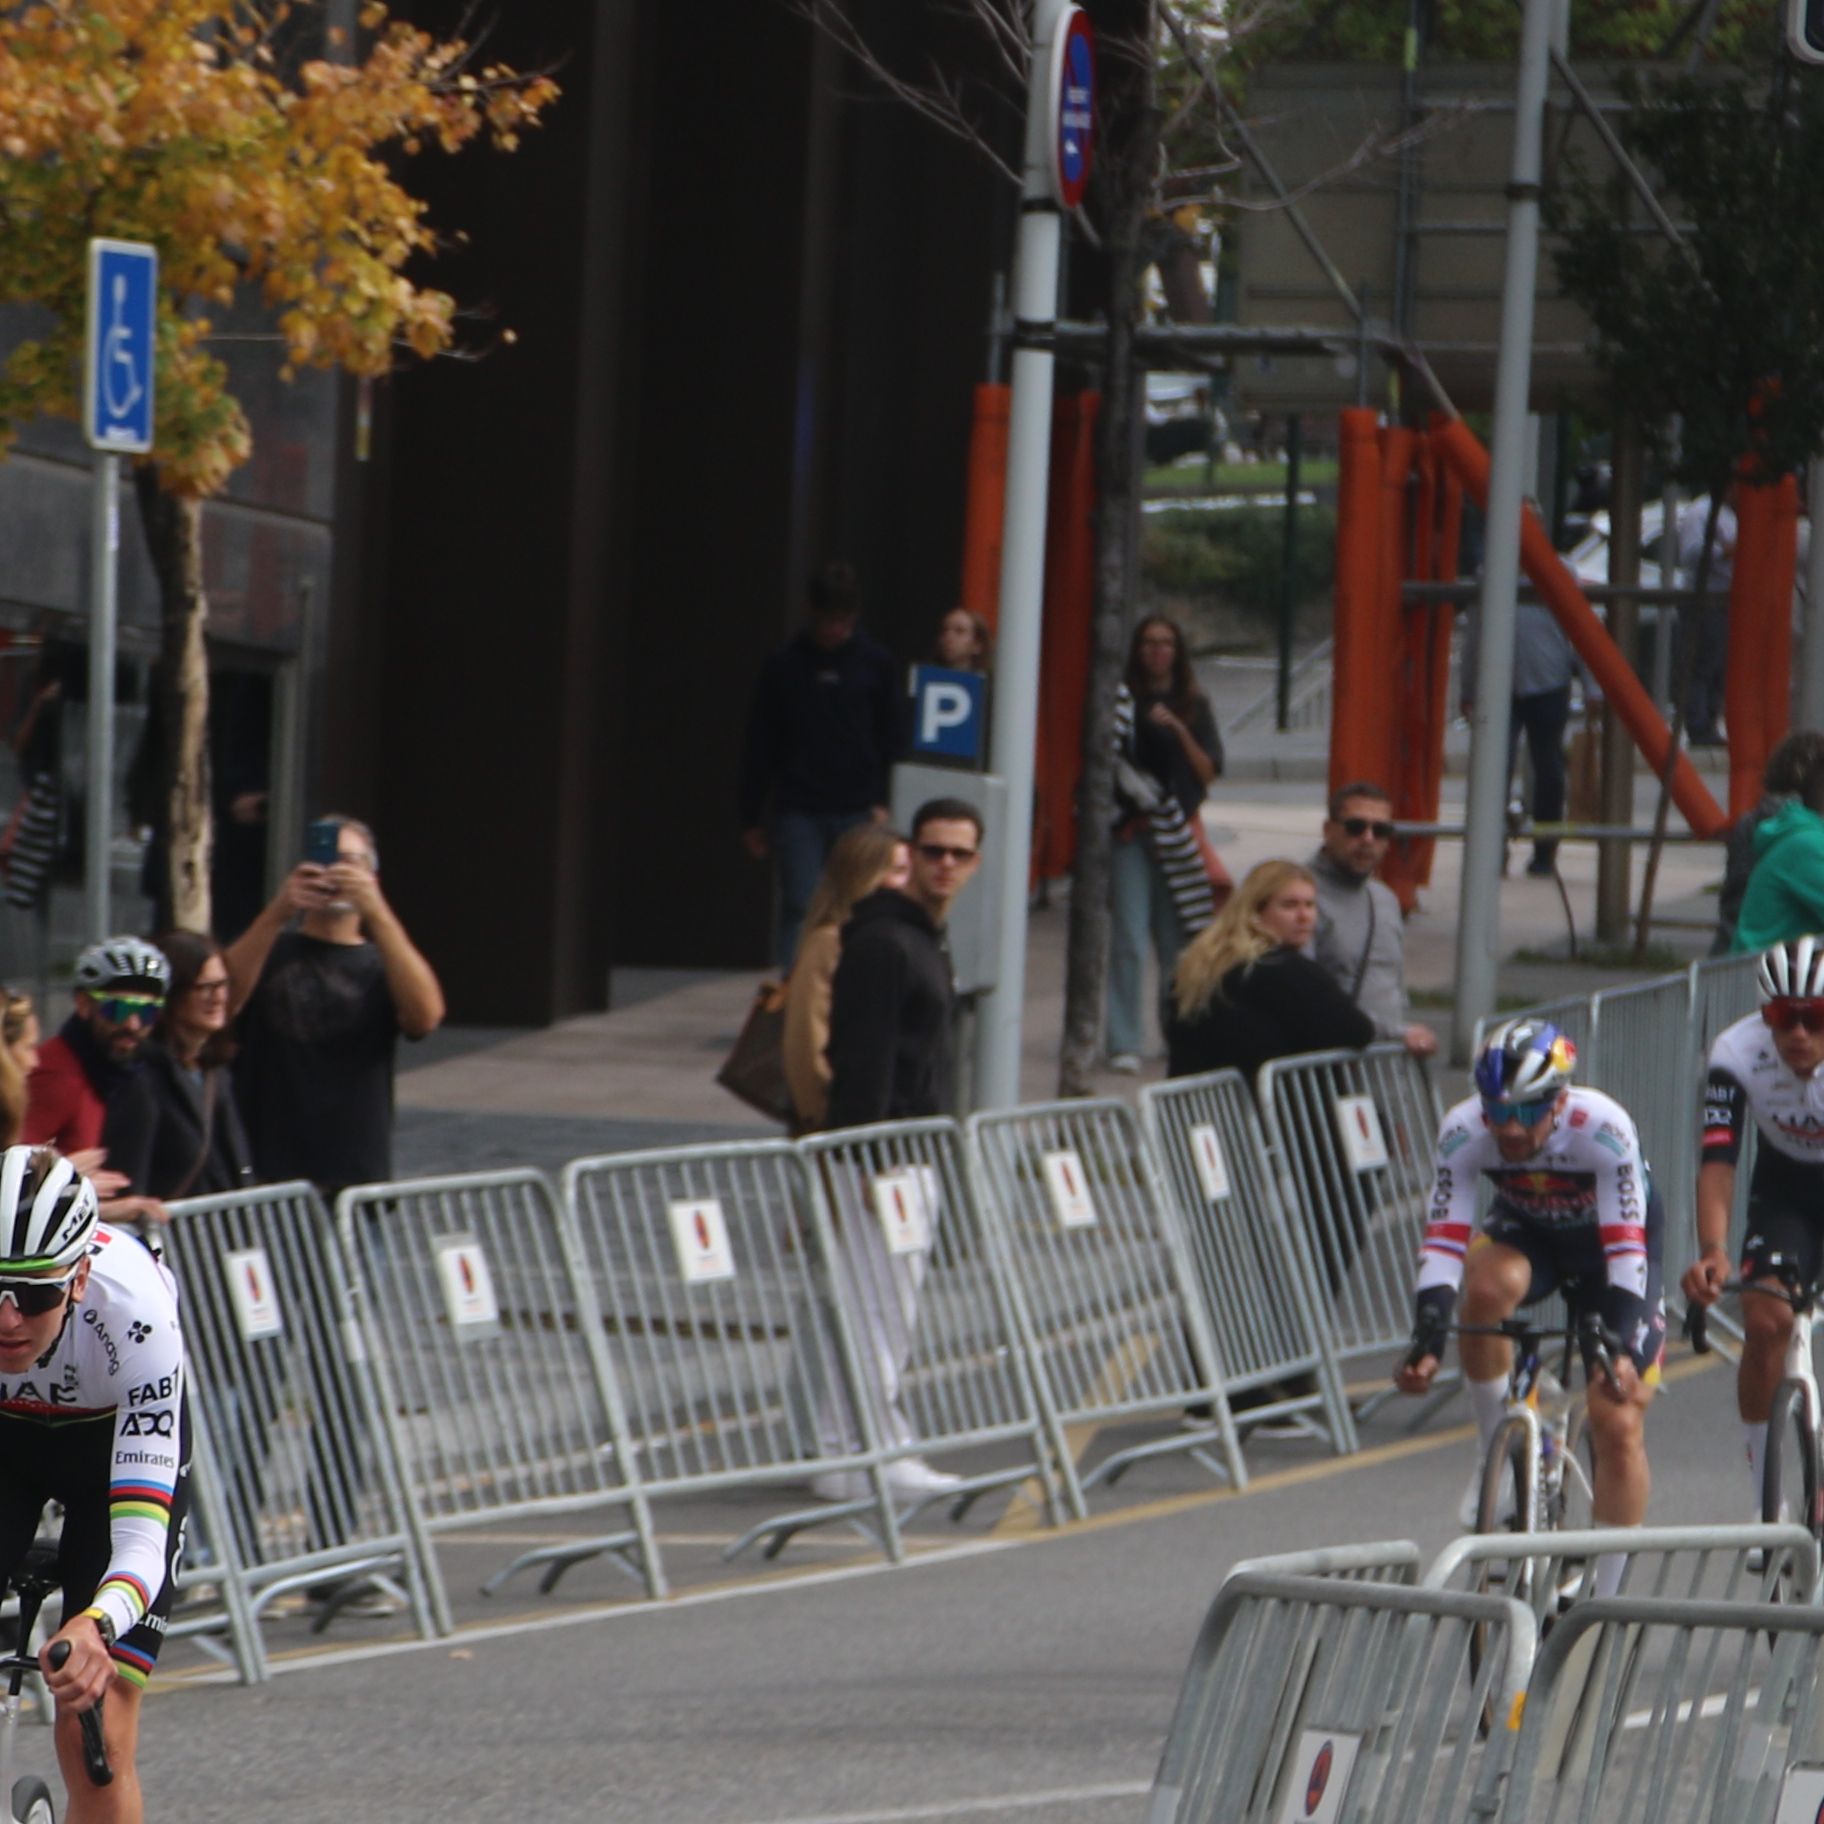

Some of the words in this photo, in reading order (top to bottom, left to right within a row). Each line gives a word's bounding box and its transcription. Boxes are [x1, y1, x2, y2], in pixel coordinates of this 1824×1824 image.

[922, 682, 971, 742] P
[1616, 1164, 1639, 1221] BOSS
[115, 1450, 175, 1469] Emirates
